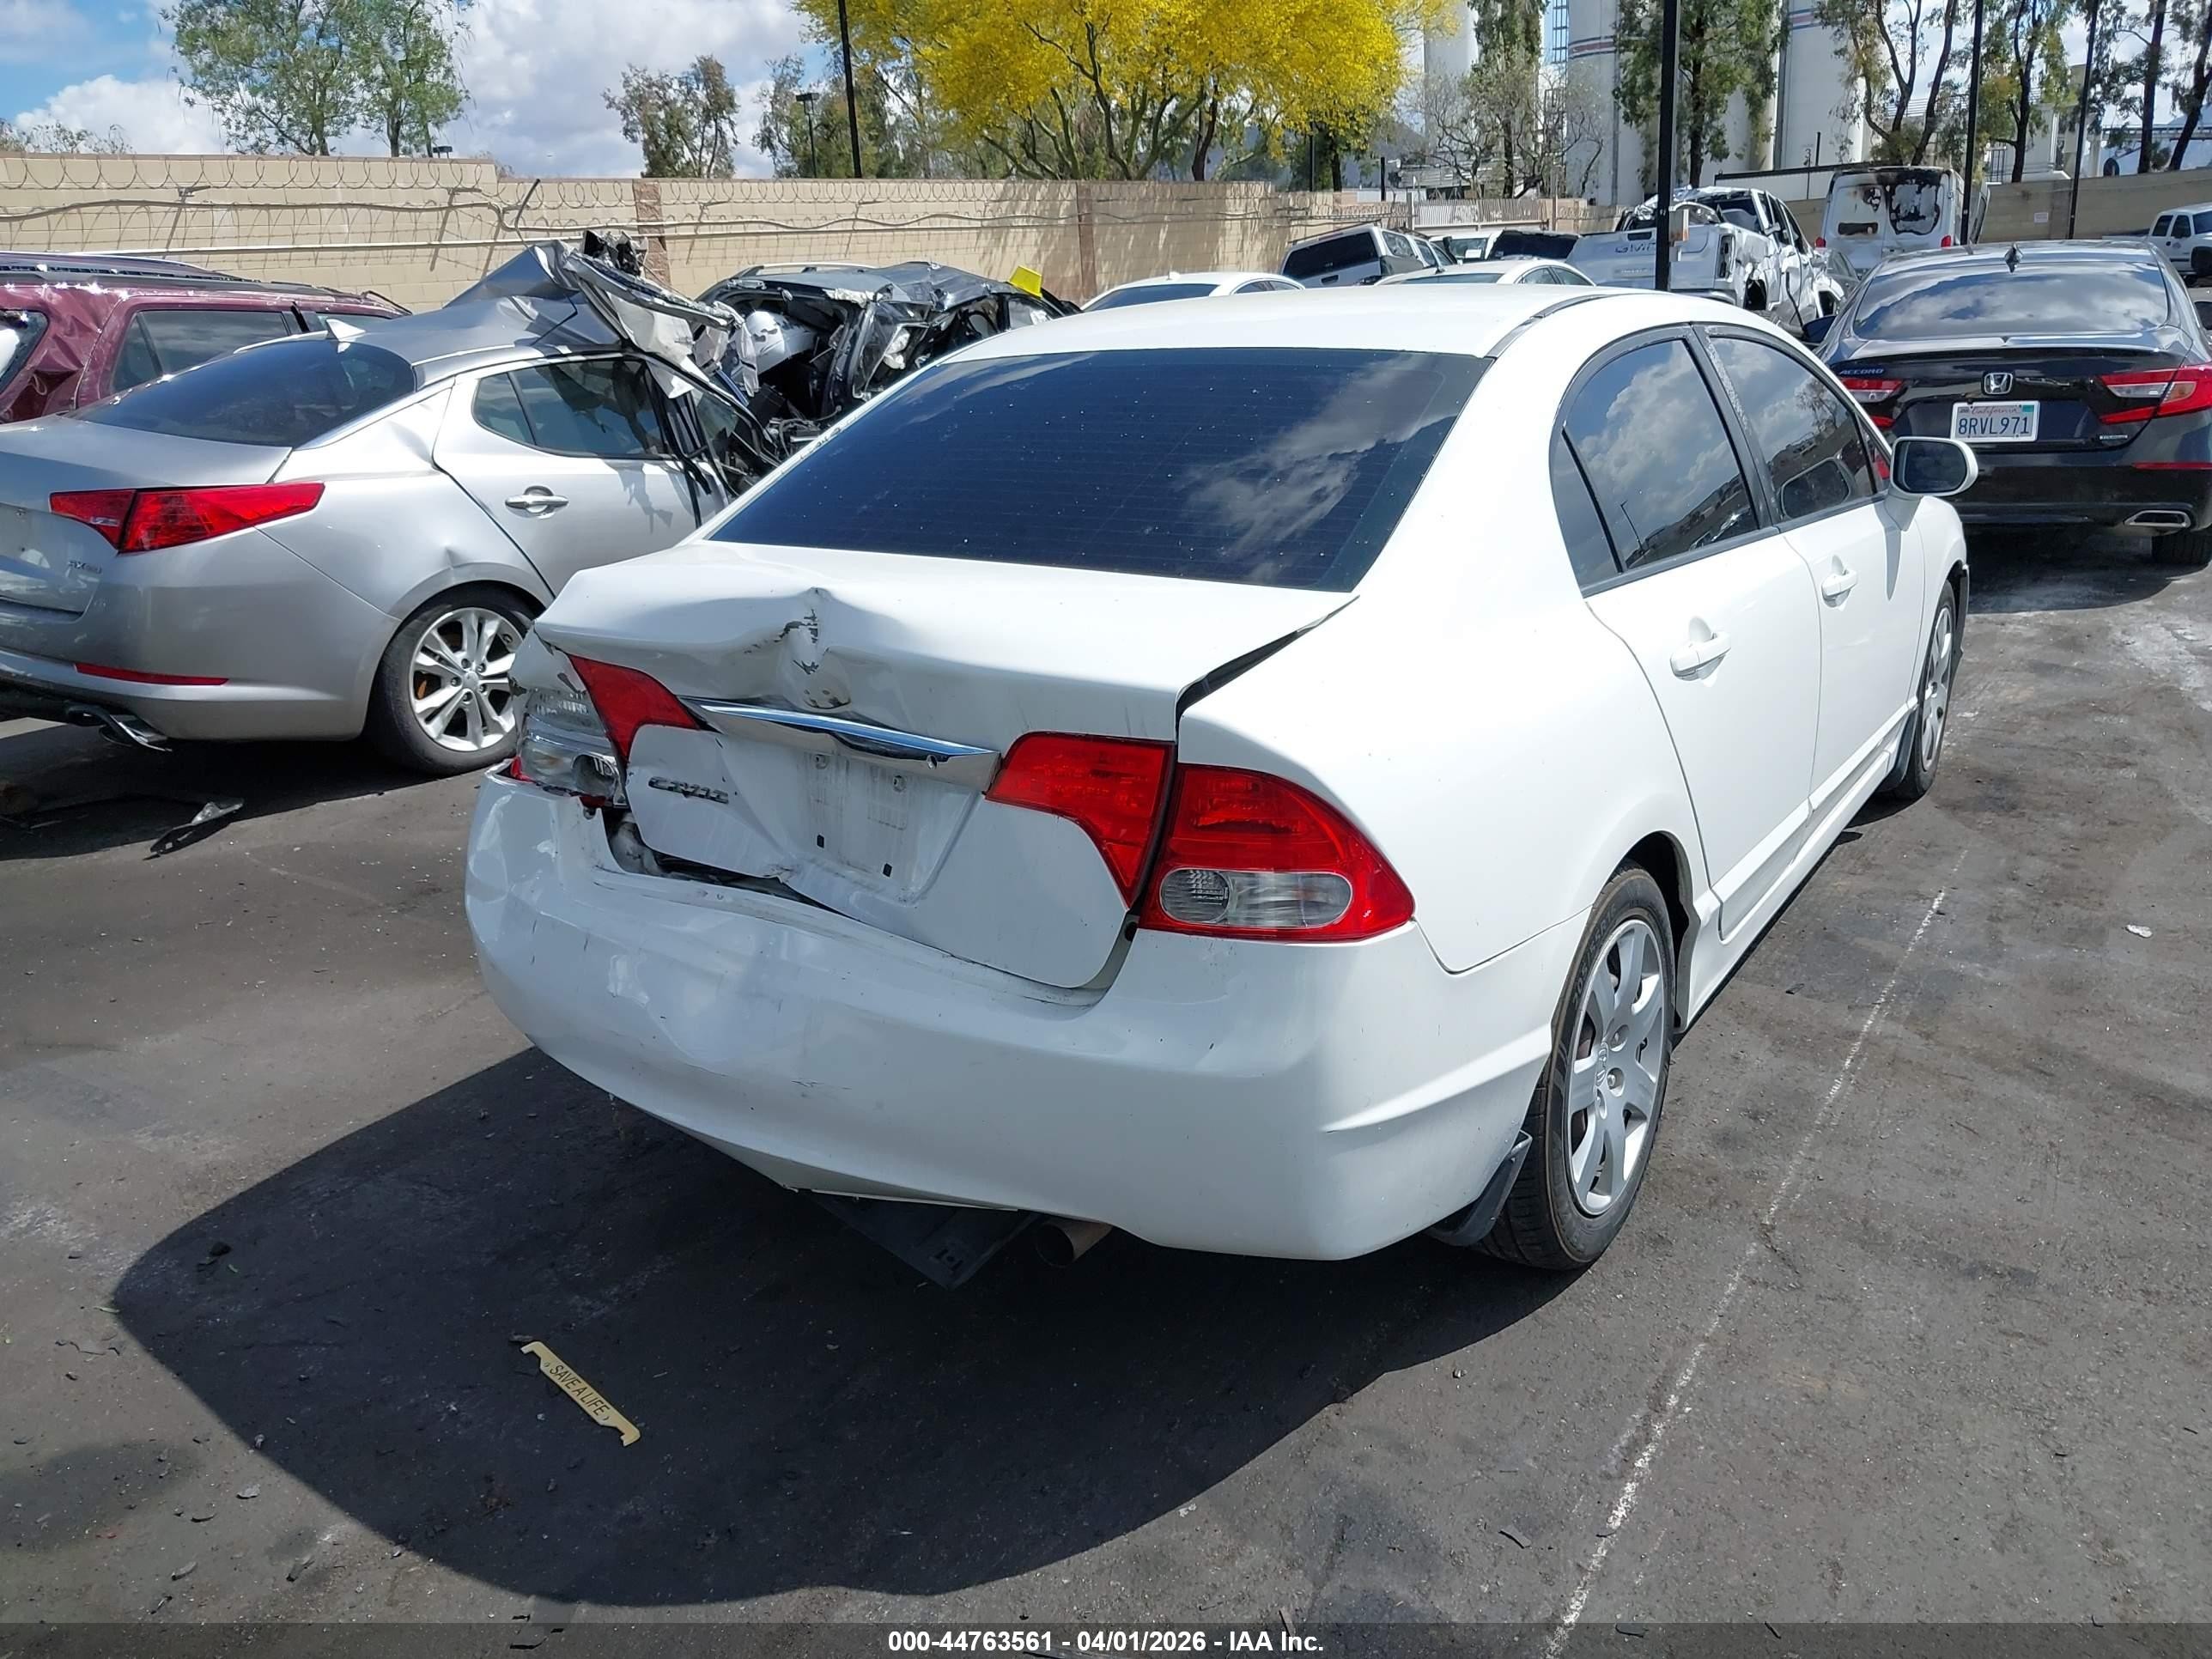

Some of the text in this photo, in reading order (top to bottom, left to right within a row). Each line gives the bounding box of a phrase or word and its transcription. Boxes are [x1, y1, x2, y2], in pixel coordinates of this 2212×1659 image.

[1959, 416, 2030, 435] 8RVL971
[550, 1364, 611, 1416] SAVE A LIFE
